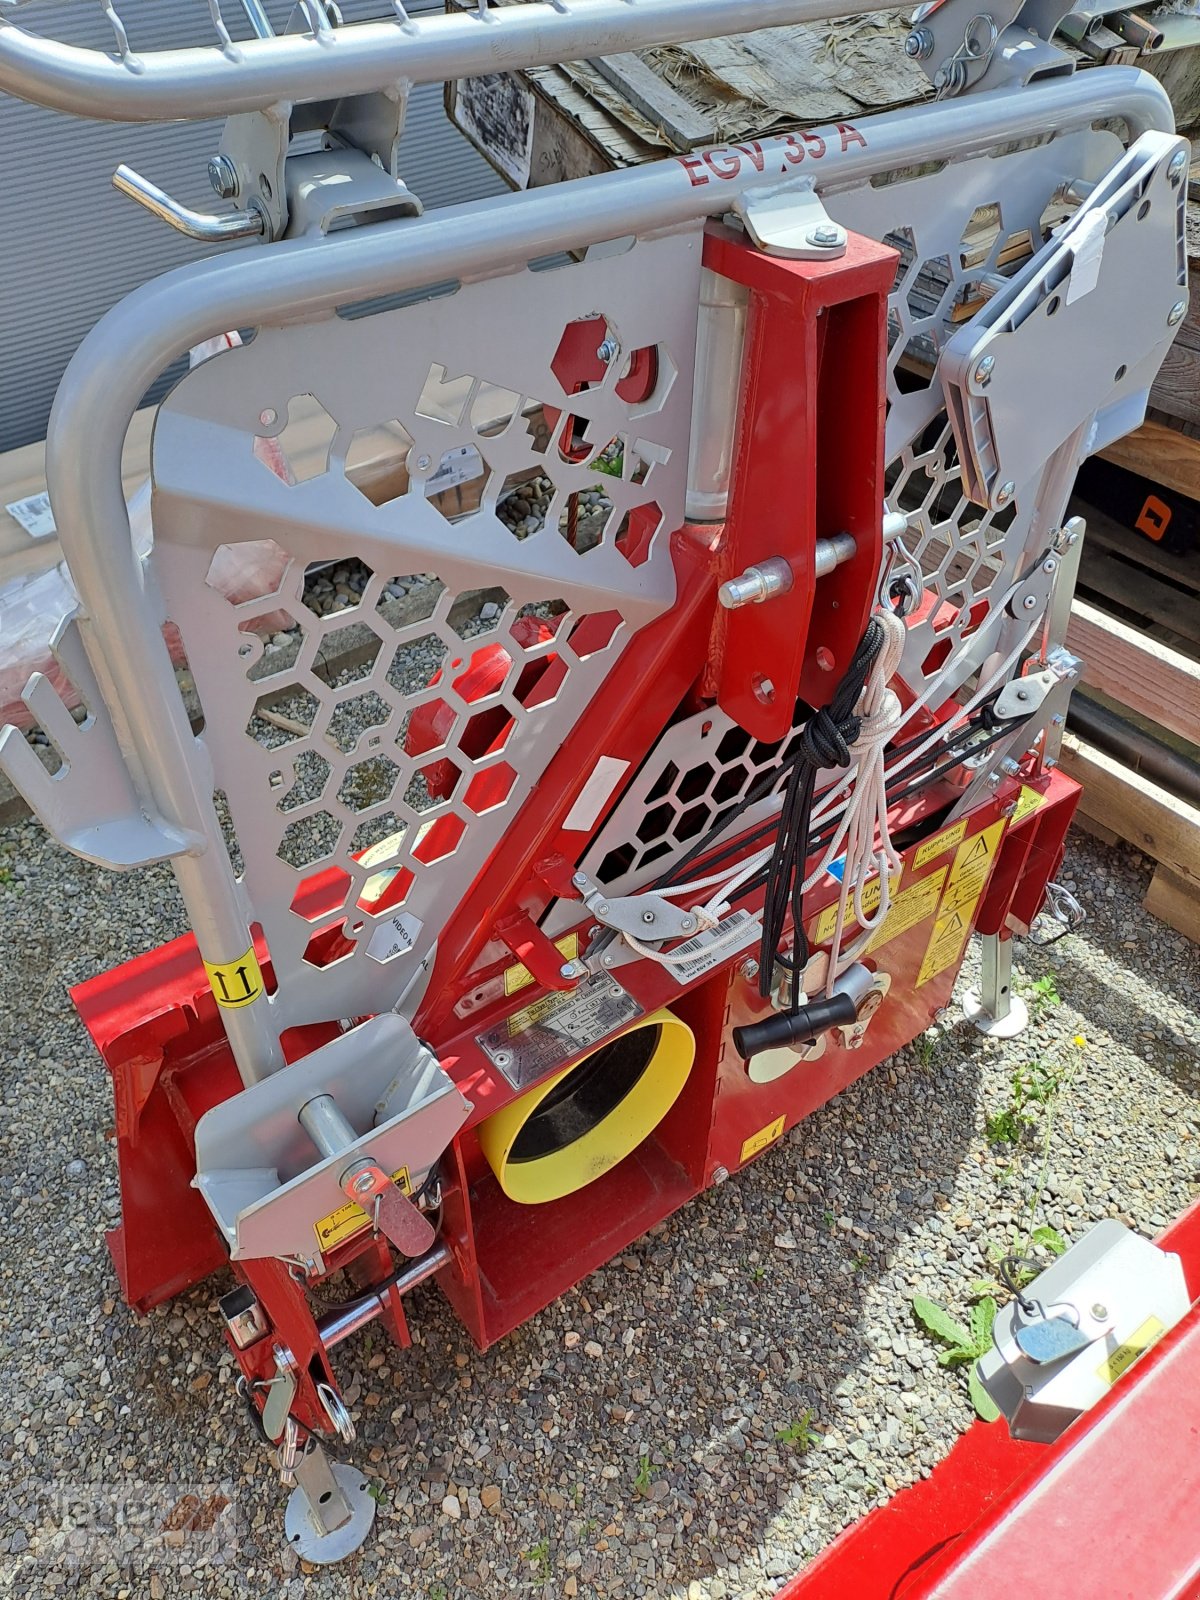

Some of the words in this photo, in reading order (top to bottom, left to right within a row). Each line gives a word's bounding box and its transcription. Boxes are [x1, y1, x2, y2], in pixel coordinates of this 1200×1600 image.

[674, 141, 765, 187] EGV
[774, 129, 827, 165] 35
[833, 122, 869, 152] A
[392, 917, 409, 940] VIDEO
